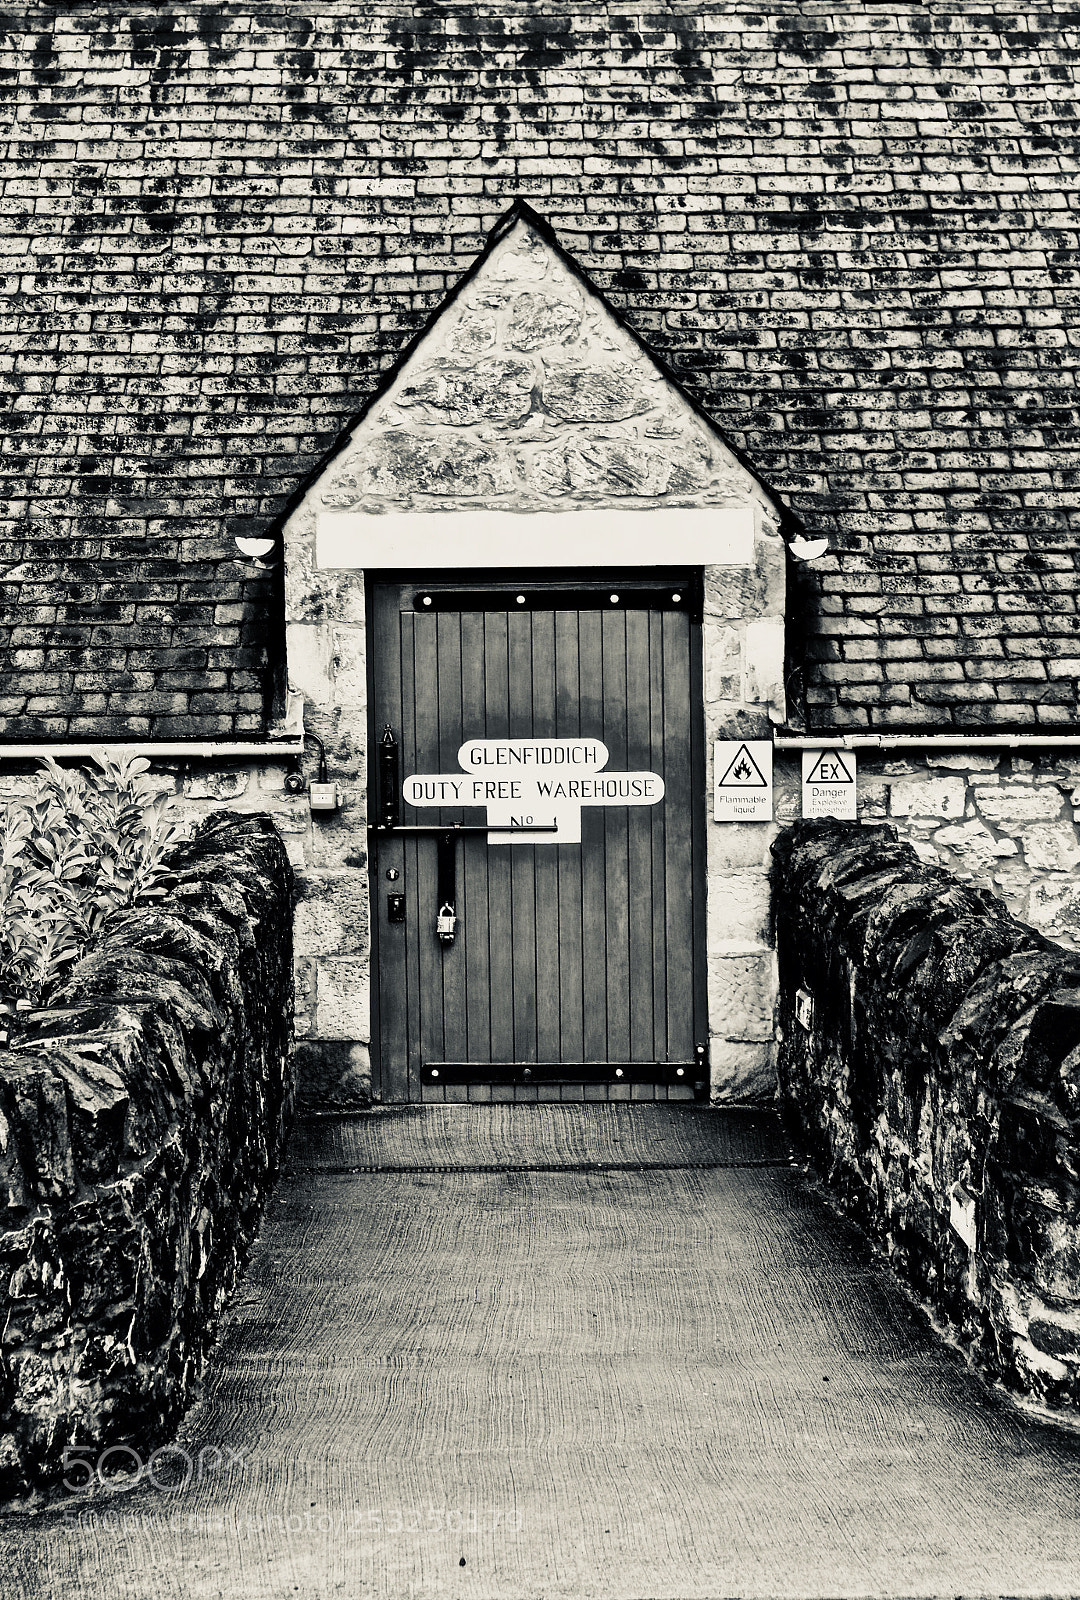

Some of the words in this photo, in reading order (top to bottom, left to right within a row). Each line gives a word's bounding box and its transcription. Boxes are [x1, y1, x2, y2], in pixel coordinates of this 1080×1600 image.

[470, 746, 596, 765] GLENFIDDICH
[820, 763, 839, 780] EX
[412, 781, 463, 800] DUTY
[473, 780, 522, 799] FREE
[536, 779, 655, 798] WAREHOUSE
[812, 787, 847, 799] Danger
[719, 795, 767, 804] Flammable
[733, 805, 755, 814] liquid
